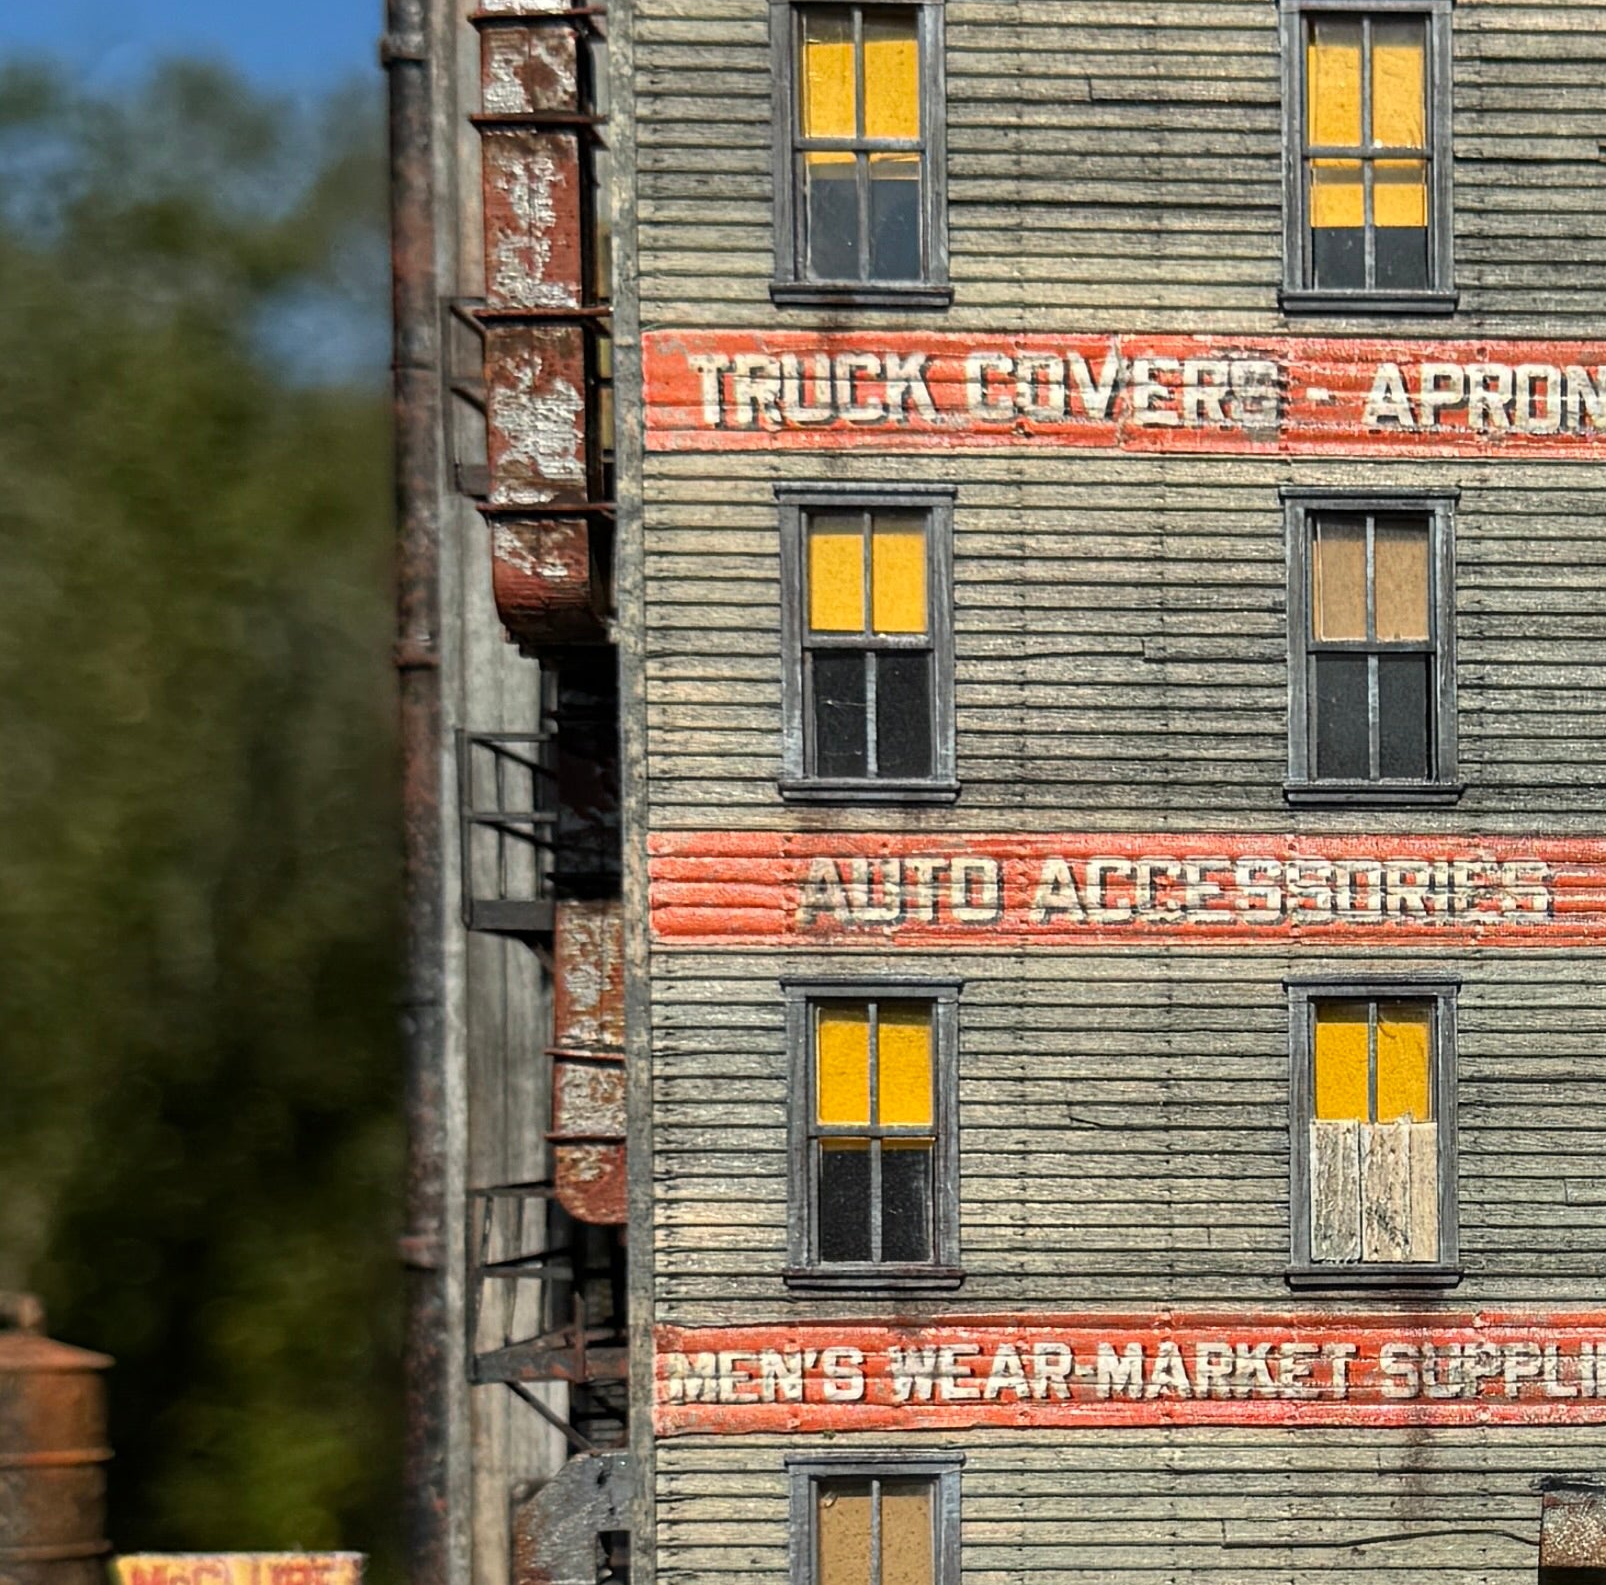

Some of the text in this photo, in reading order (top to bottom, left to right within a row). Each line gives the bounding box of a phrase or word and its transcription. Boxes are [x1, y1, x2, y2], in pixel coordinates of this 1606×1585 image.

[687, 351, 938, 427] TRUCK
[801, 856, 1552, 925] AUTO ACCESSORIES
[667, 1346, 865, 1404] MEN'S
